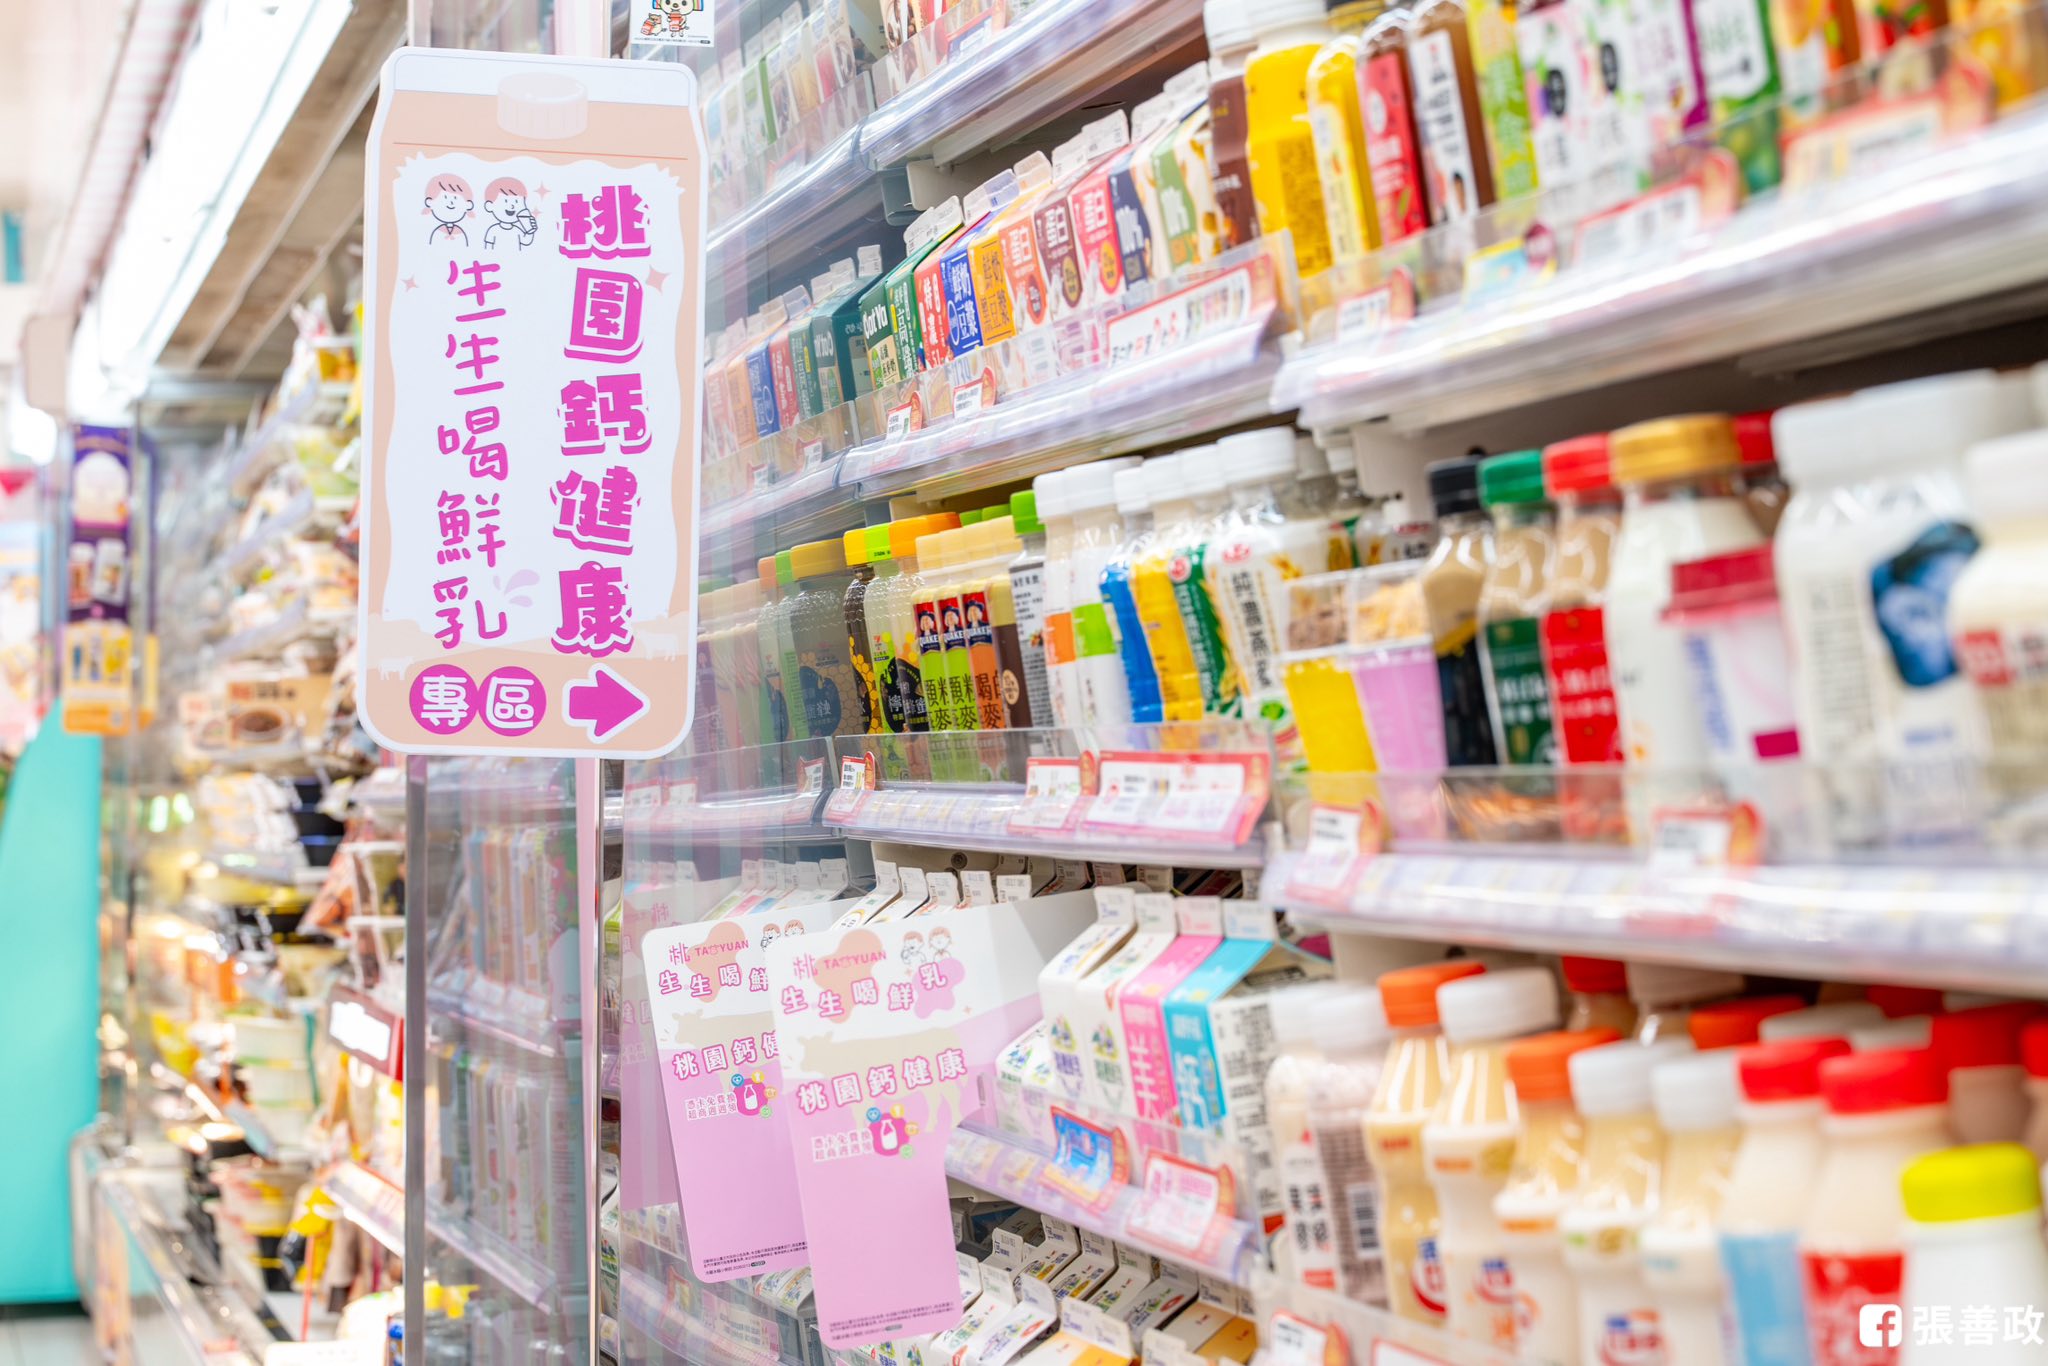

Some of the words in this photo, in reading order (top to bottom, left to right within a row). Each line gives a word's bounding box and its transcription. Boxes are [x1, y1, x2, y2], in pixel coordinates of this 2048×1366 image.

[433, 260, 509, 649] 生生喝鮮乳
[550, 185, 652, 658] 桃園鈣健康
[420, 674, 534, 729] 專區
[781, 961, 949, 1018] 生生喝鮮乳
[796, 1047, 968, 1116] 桃園鈣健康
